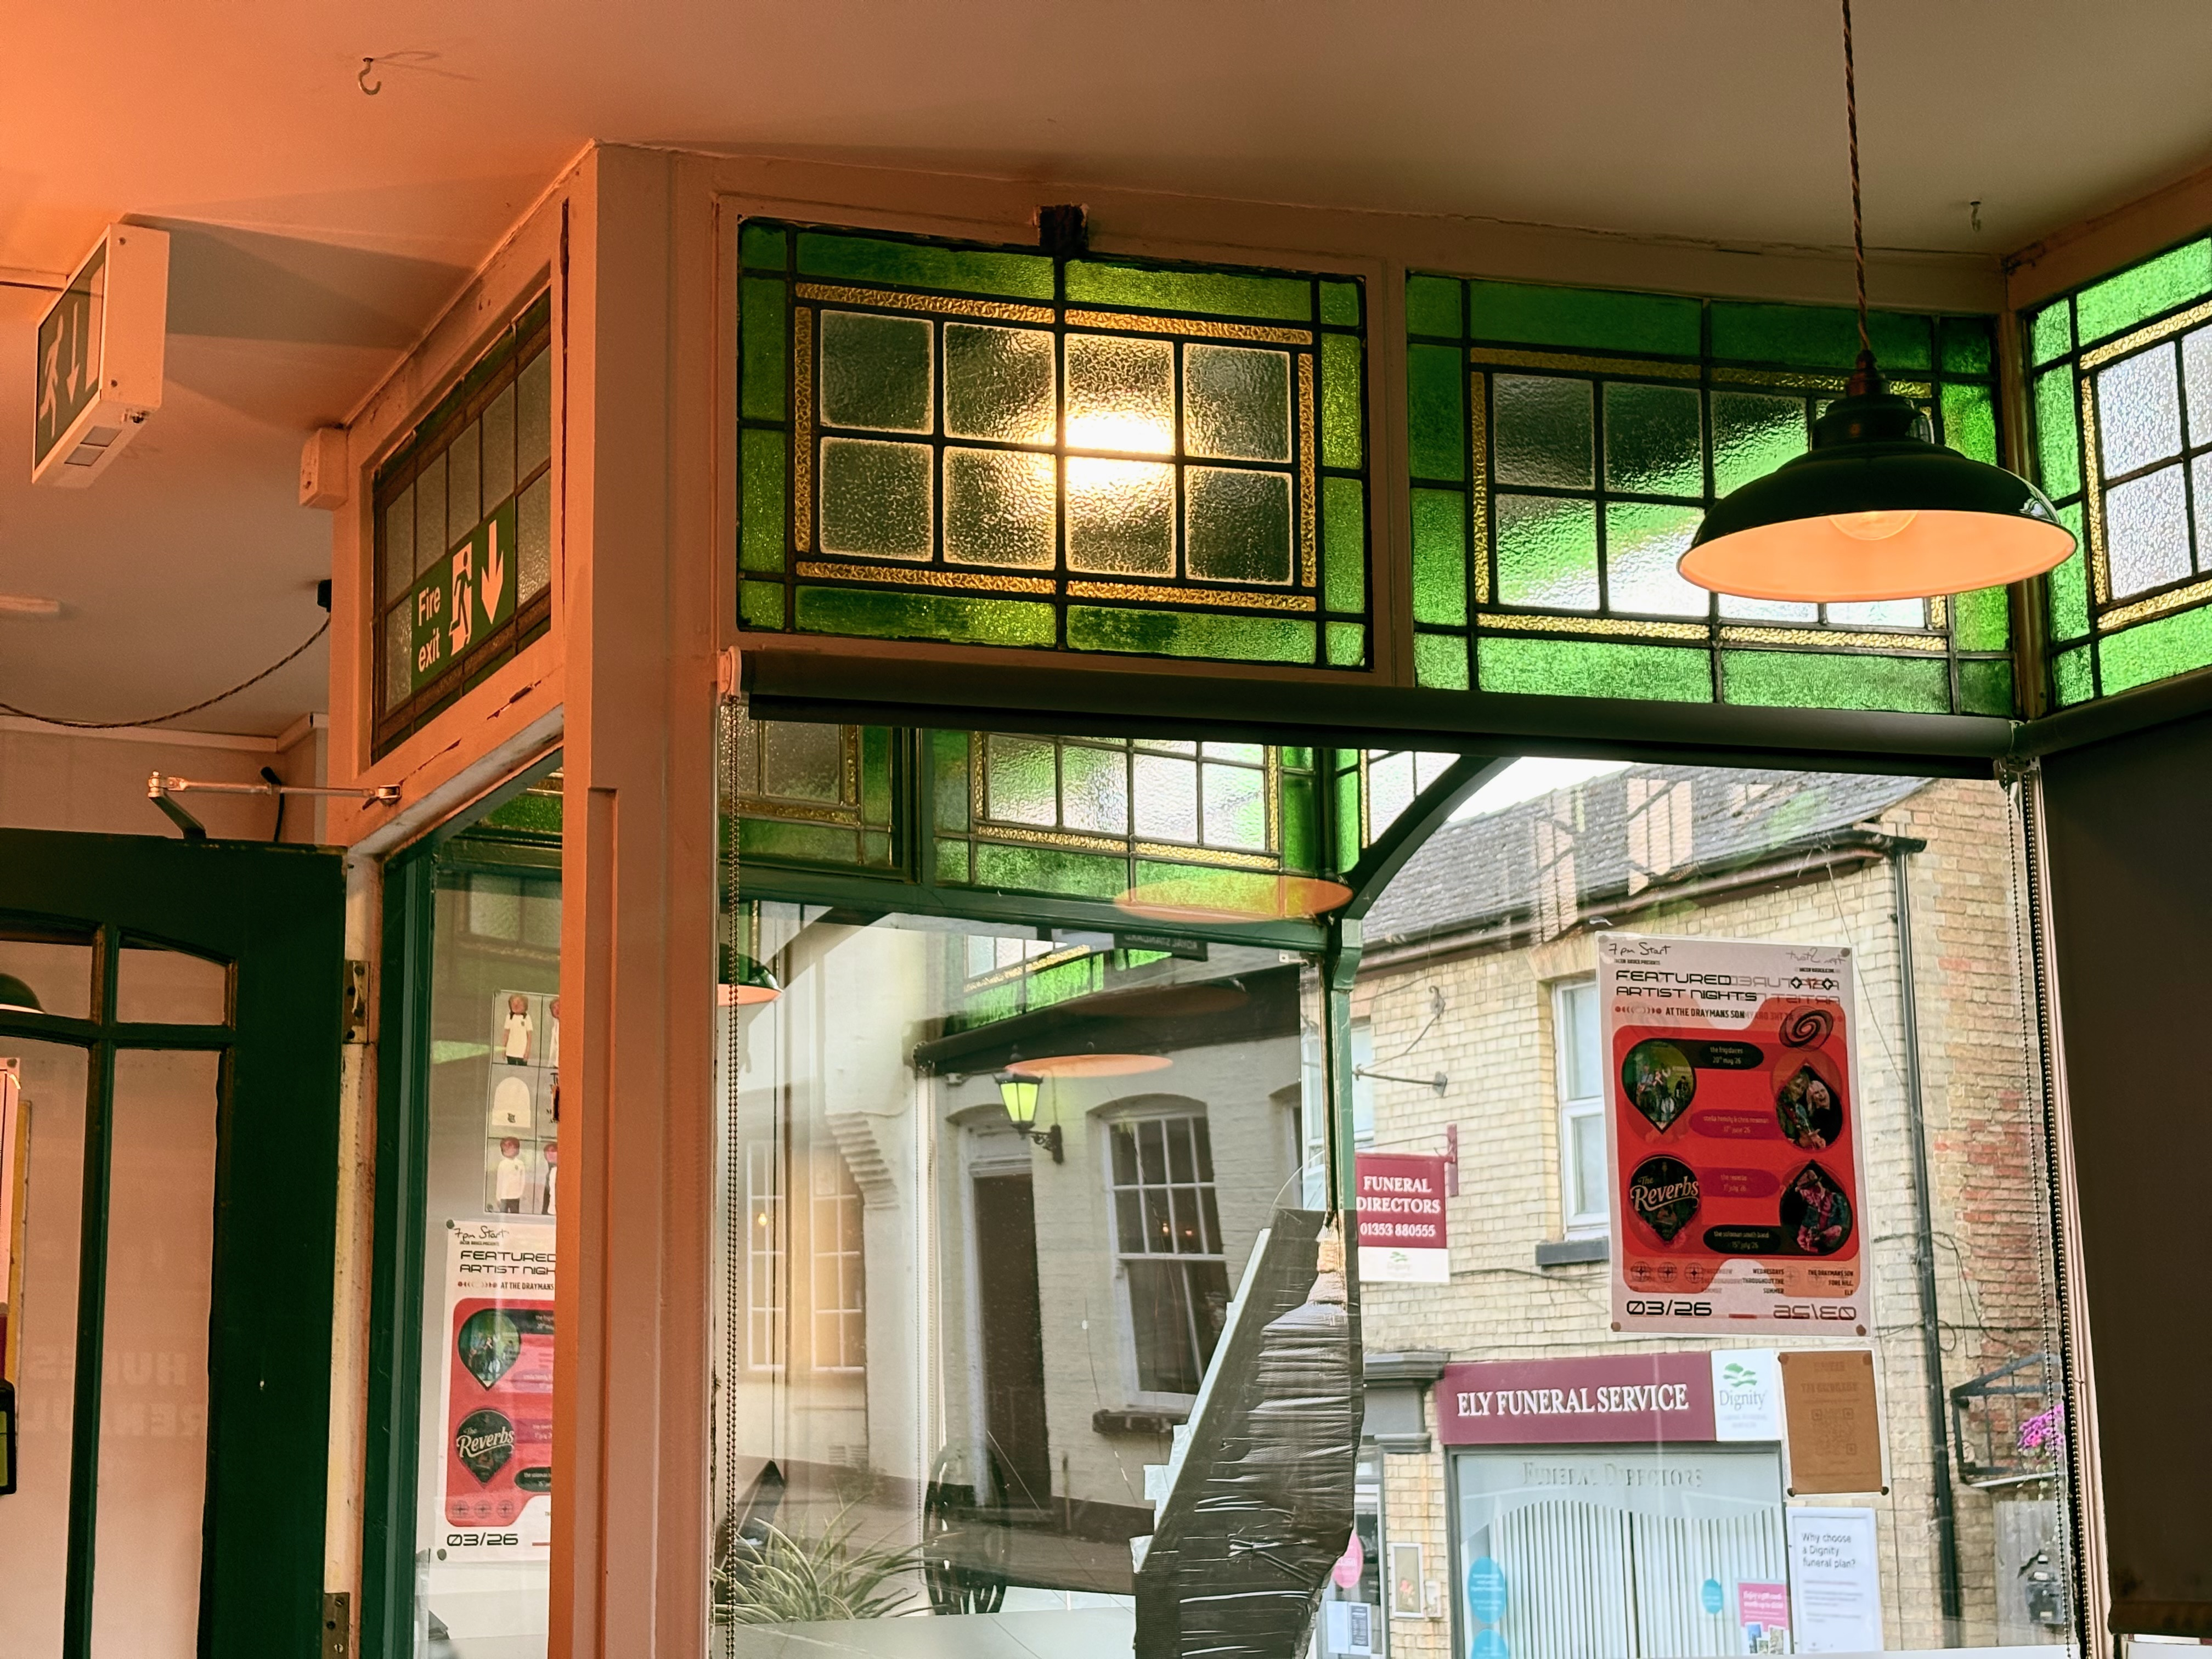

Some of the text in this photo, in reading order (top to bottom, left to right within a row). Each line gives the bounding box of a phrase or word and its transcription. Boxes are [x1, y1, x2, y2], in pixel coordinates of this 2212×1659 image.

[418, 586, 441, 627] Fire
[418, 627, 441, 673] exit
[1638, 941, 1672, 955] Start
[1616, 969, 1731, 985] FEATURED
[1616, 986, 1757, 1002] ARTIST NIGHTS
[1666, 1007, 1674, 1015] AT
[1675, 1008, 1689, 1016] THE
[1691, 1008, 1729, 1018] DRAYMANS
[1730, 1010, 1745, 1019] SON
[1363, 1176, 1432, 1193] FUNERAL
[1638, 1176, 1654, 1186] The
[1629, 1176, 1700, 1212] Reverbs
[1356, 1196, 1441, 1214] DIRECTORS
[453, 1225, 510, 1242] 7pm Start
[1360, 1222, 1436, 1238] 01353 880555
[459, 1263, 520, 1274] ARTIST
[500, 1281, 555, 1291] AT THE DRAYMANS
[1626, 1299, 1712, 1316] 03/26
[1457, 1383, 1689, 1416] ELY FUNERAL SERVICE
[1718, 1389, 1767, 1411] Dignity
[456, 1426, 515, 1458] Reverbs
[446, 1532, 519, 1547] 03/26
[1801, 1532, 1852, 1544] Why choose
[1809, 1546, 1840, 1558] Dignity
[1802, 1558, 1857, 1569] funeral plan?
